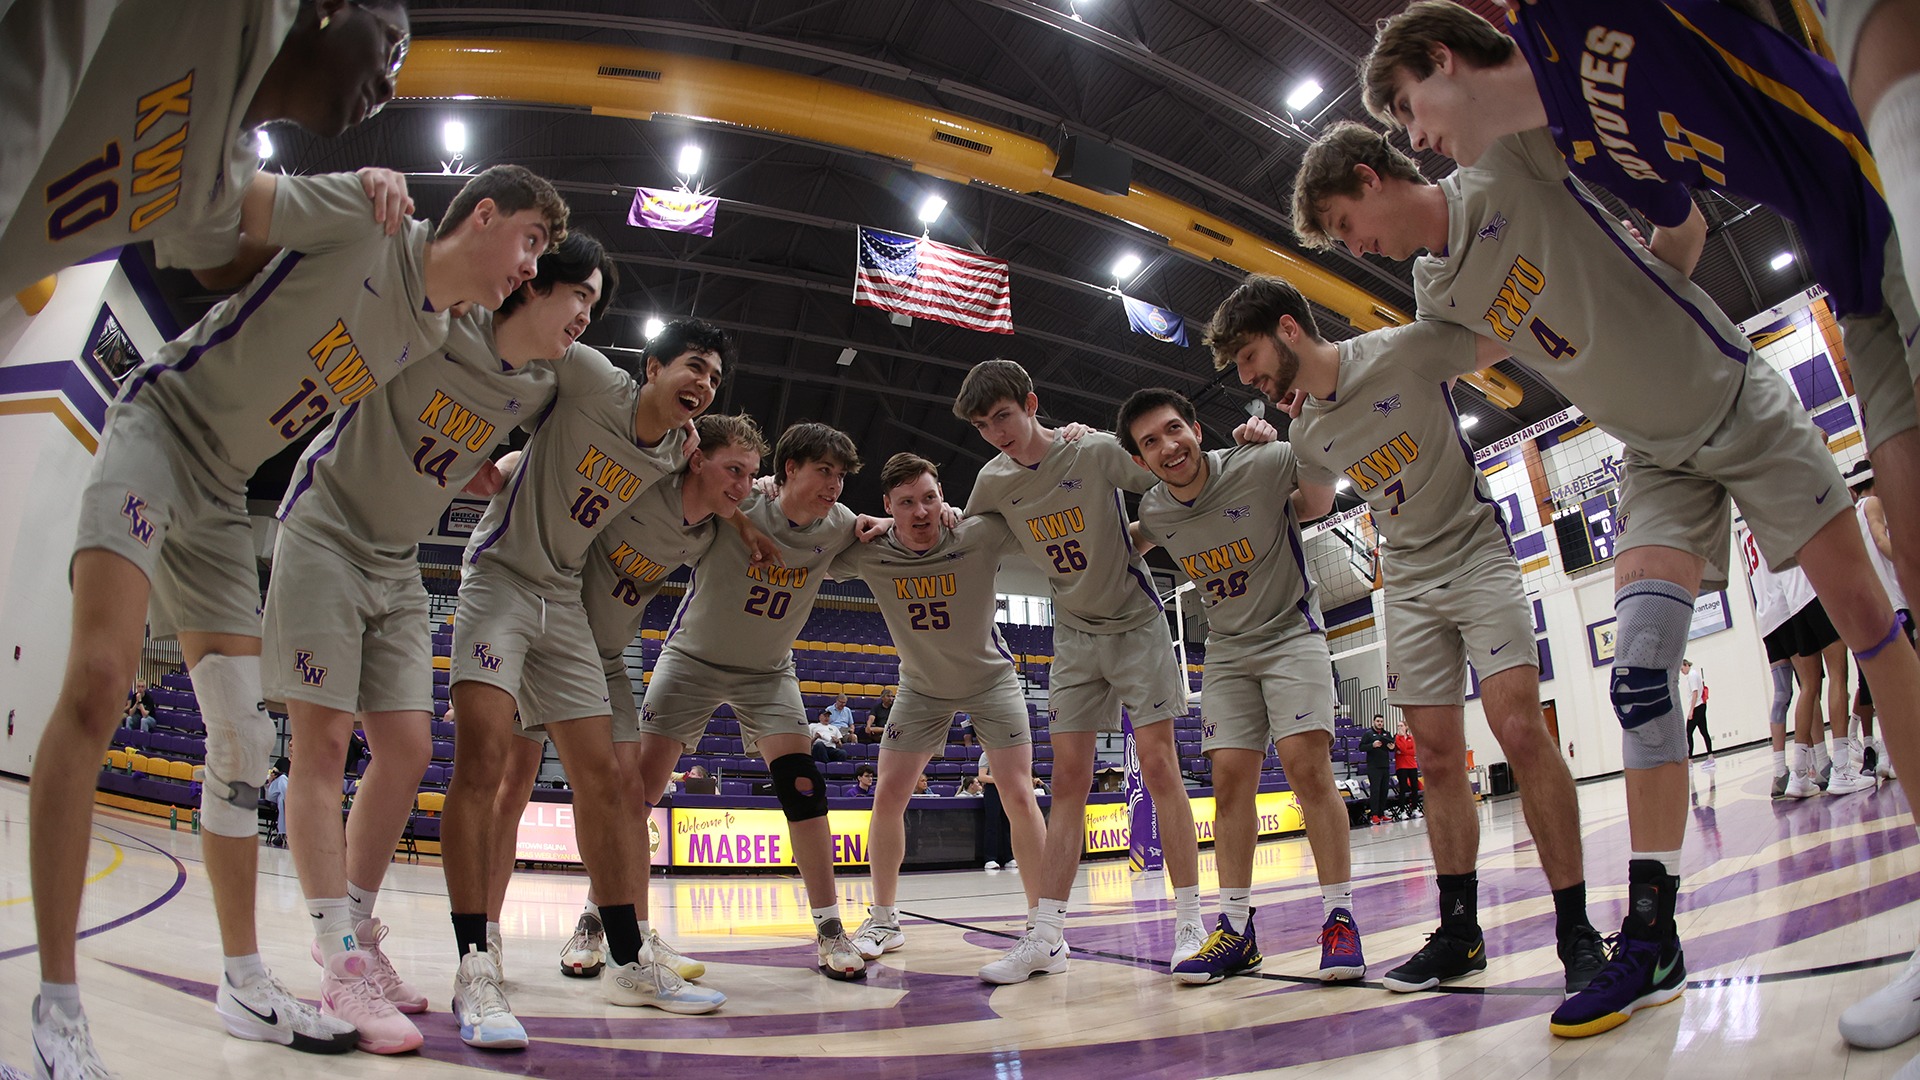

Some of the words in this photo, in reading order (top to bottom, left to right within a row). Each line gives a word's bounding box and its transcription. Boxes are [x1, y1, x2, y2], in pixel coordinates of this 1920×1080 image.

[129, 68, 195, 233] KWU
[46, 138, 122, 242] 10
[1483, 254, 1546, 342] KWU
[1805, 284, 1826, 300] KAN
[1528, 314, 1580, 361] 4
[307, 317, 378, 406] KWU
[267, 376, 330, 440] 13
[417, 388, 496, 453] KWU
[1491, 428, 1535, 453] WESLEYAN
[1535, 410, 1569, 433] COYOTES
[412, 435, 460, 488] 14
[575, 444, 642, 503] KWU
[1344, 430, 1419, 492] KWU
[569, 486, 610, 529] 16
[1384, 478, 1407, 518] 7
[1551, 475, 1596, 501] MABEE
[120, 491, 156, 549] KW
[1026, 506, 1086, 543] KWU
[1316, 516, 1342, 533] KANSAS
[1342, 503, 1369, 523] WESLEY
[609, 540, 667, 583] KWU
[1045, 539, 1089, 575] 26
[1180, 537, 1256, 580] KWU
[743, 585, 792, 621] 20
[893, 573, 957, 600] KWU
[1694, 600, 1720, 613] vantage
[908, 601, 951, 632] 25
[294, 649, 328, 688] KW
[472, 642, 503, 673] KW
[677, 815, 722, 835] Welcome
[725, 811, 735, 829] to
[1089, 828, 1130, 849] KANS
[516, 842, 542, 850] NTOWN
[688, 833, 781, 864] MABEE
